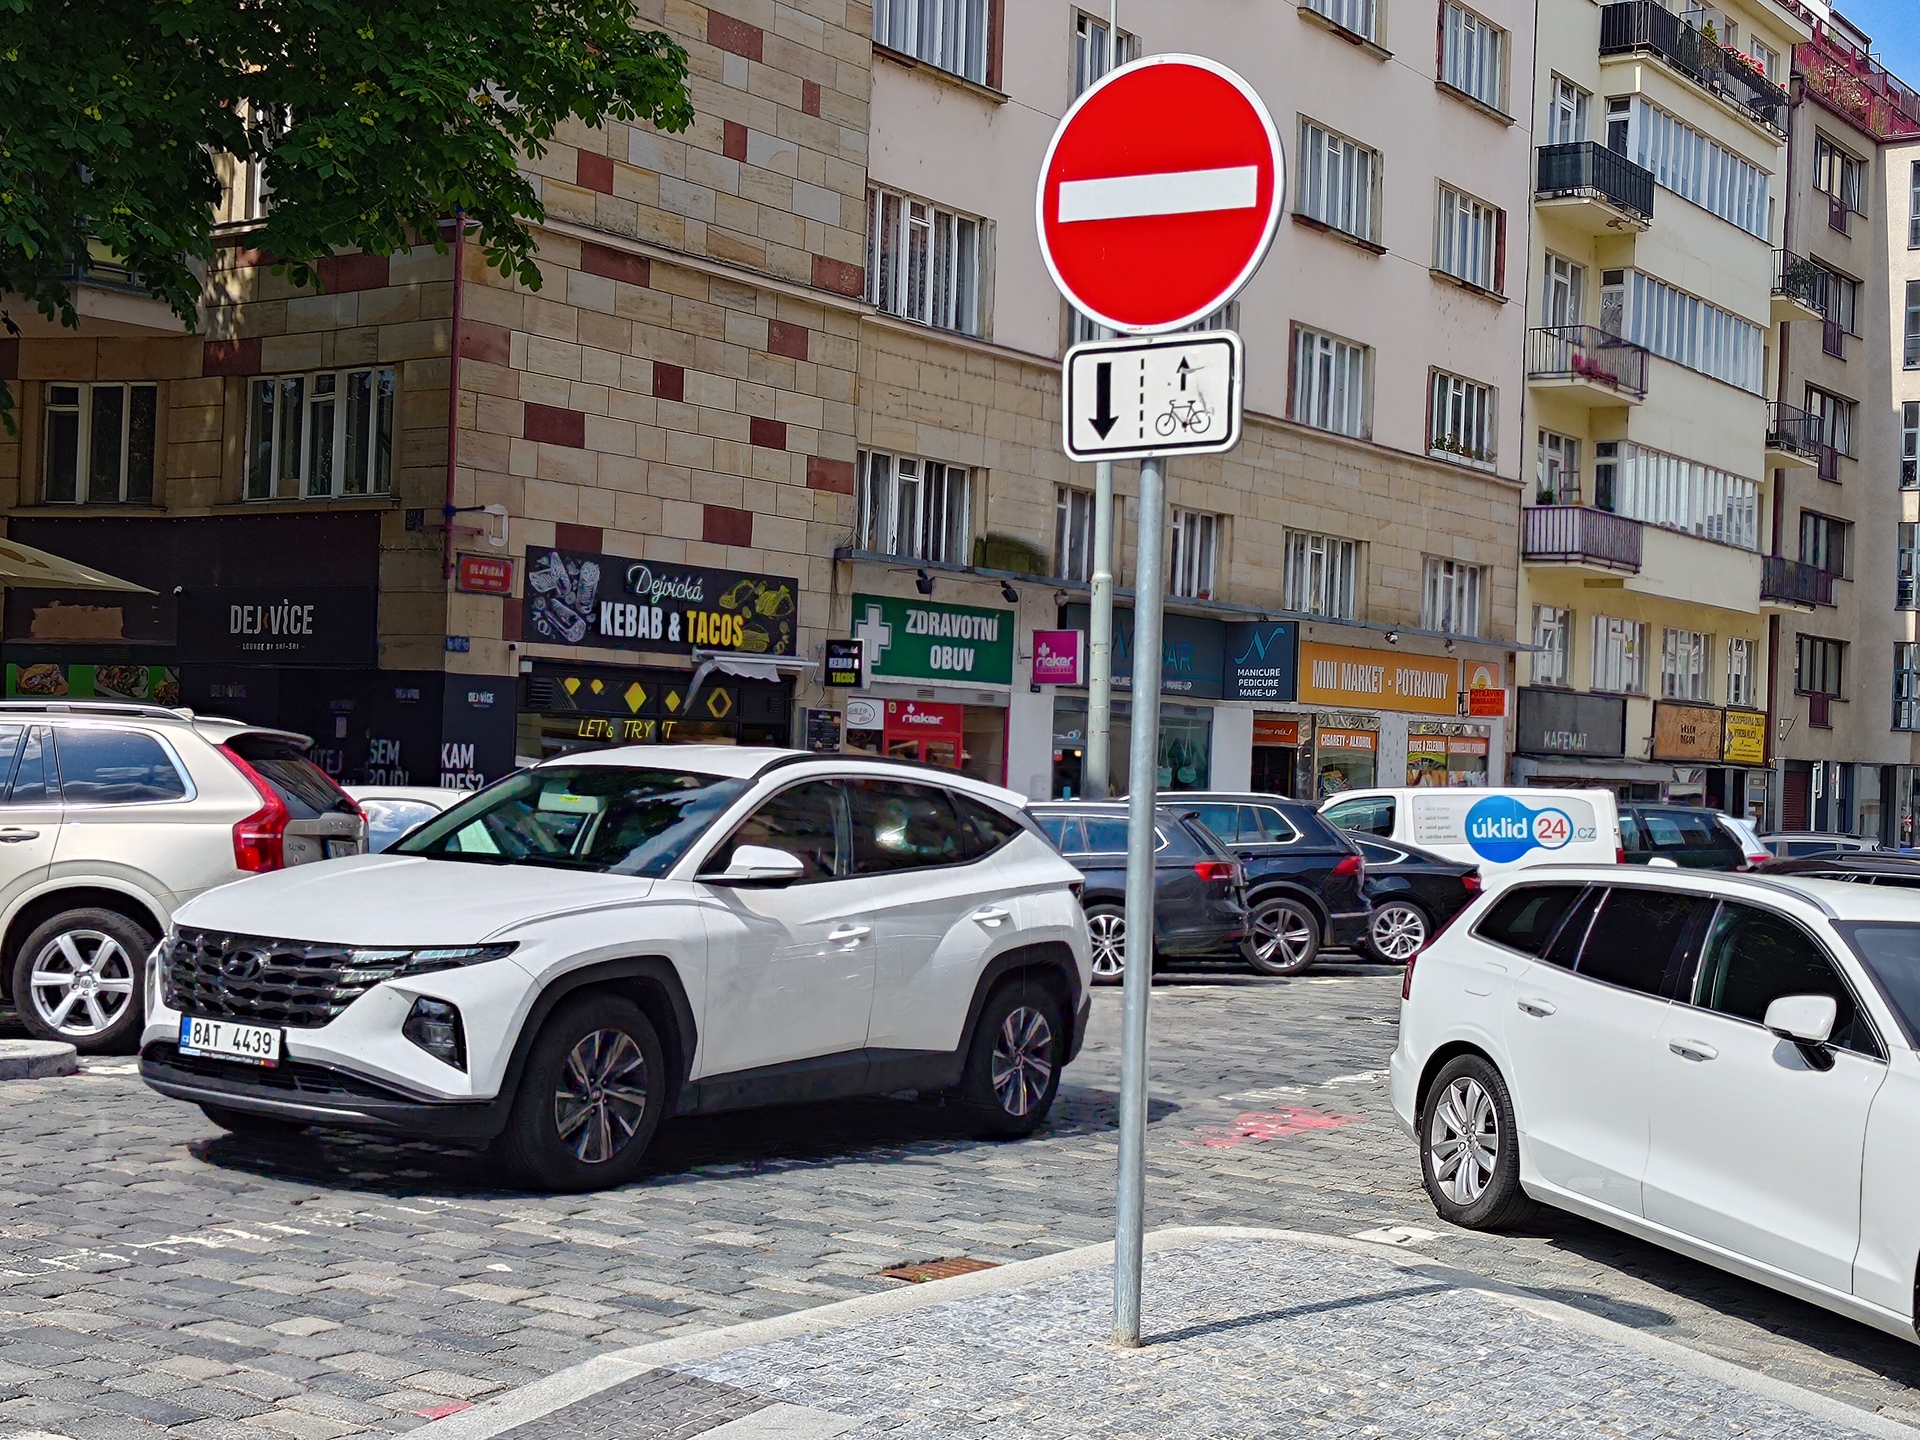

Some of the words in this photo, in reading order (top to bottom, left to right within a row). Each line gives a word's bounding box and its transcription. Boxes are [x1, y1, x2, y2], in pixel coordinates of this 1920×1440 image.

[627, 565, 704, 604] Dejvická
[600, 601, 663, 640] KEBAB
[668, 612, 681, 642] &
[686, 610, 744, 647] TACOS
[905, 609, 999, 642] ZDRAVOTNÍ
[829, 658, 852, 669] KEBAB
[930, 645, 975, 672] OBUV
[1036, 652, 1074, 668] rieker
[832, 672, 855, 683] TACOS
[1237, 668, 1281, 677] MANICURE
[1312, 659, 1338, 690] MINI
[1341, 663, 1385, 694] MARKET
[1395, 668, 1449, 699] POTRAVINY
[1238, 679, 1279, 687] PEDICURE
[1239, 689, 1277, 697] MAKE-UP
[902, 713, 944, 725] rieker
[624, 720, 655, 739] TRY
[1321, 733, 1346, 747] CIGARETY
[1350, 735, 1372, 749] ALKOHOL
[1544, 731, 1587, 750] KAFEMAT
[370, 739, 400, 765] SEM
[441, 743, 474, 769] KAM
[1472, 817, 1528, 839] úklid
[1537, 818, 1566, 839] 24
[193, 1022, 221, 1047] 8AT
[233, 1028, 272, 1055] 4439
